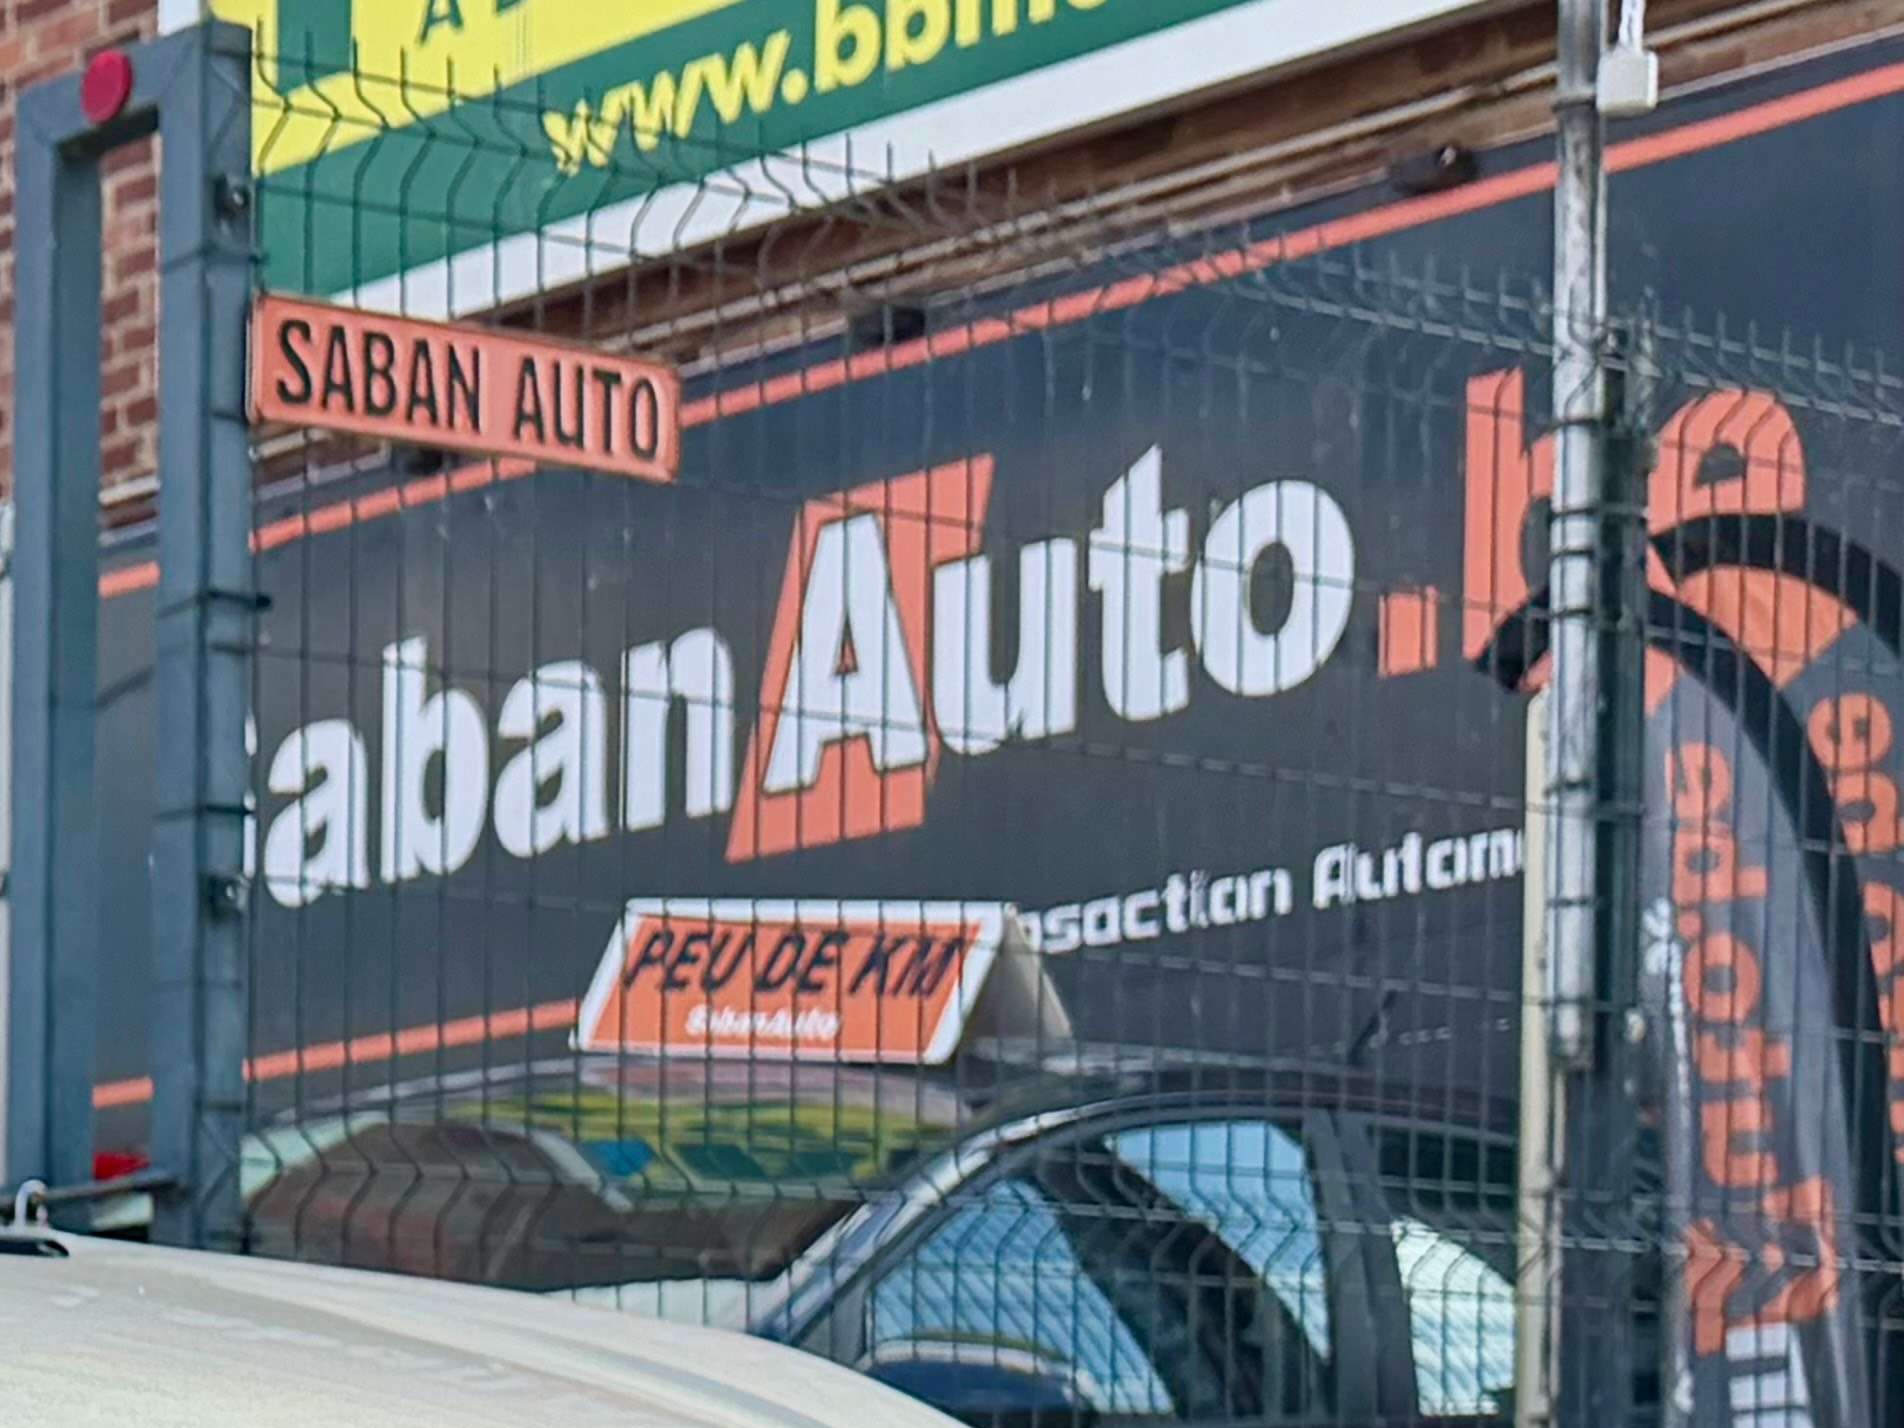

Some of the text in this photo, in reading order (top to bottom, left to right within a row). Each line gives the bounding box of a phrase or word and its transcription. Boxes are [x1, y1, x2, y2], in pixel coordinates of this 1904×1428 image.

[541, 0, 1107, 176] www.bb
[276, 319, 660, 461] SABAN AUTO
[244, 366, 1805, 908] abanAuto.be
[1313, 827, 1523, 909] Autom
[623, 928, 966, 998] PEU DE KM
